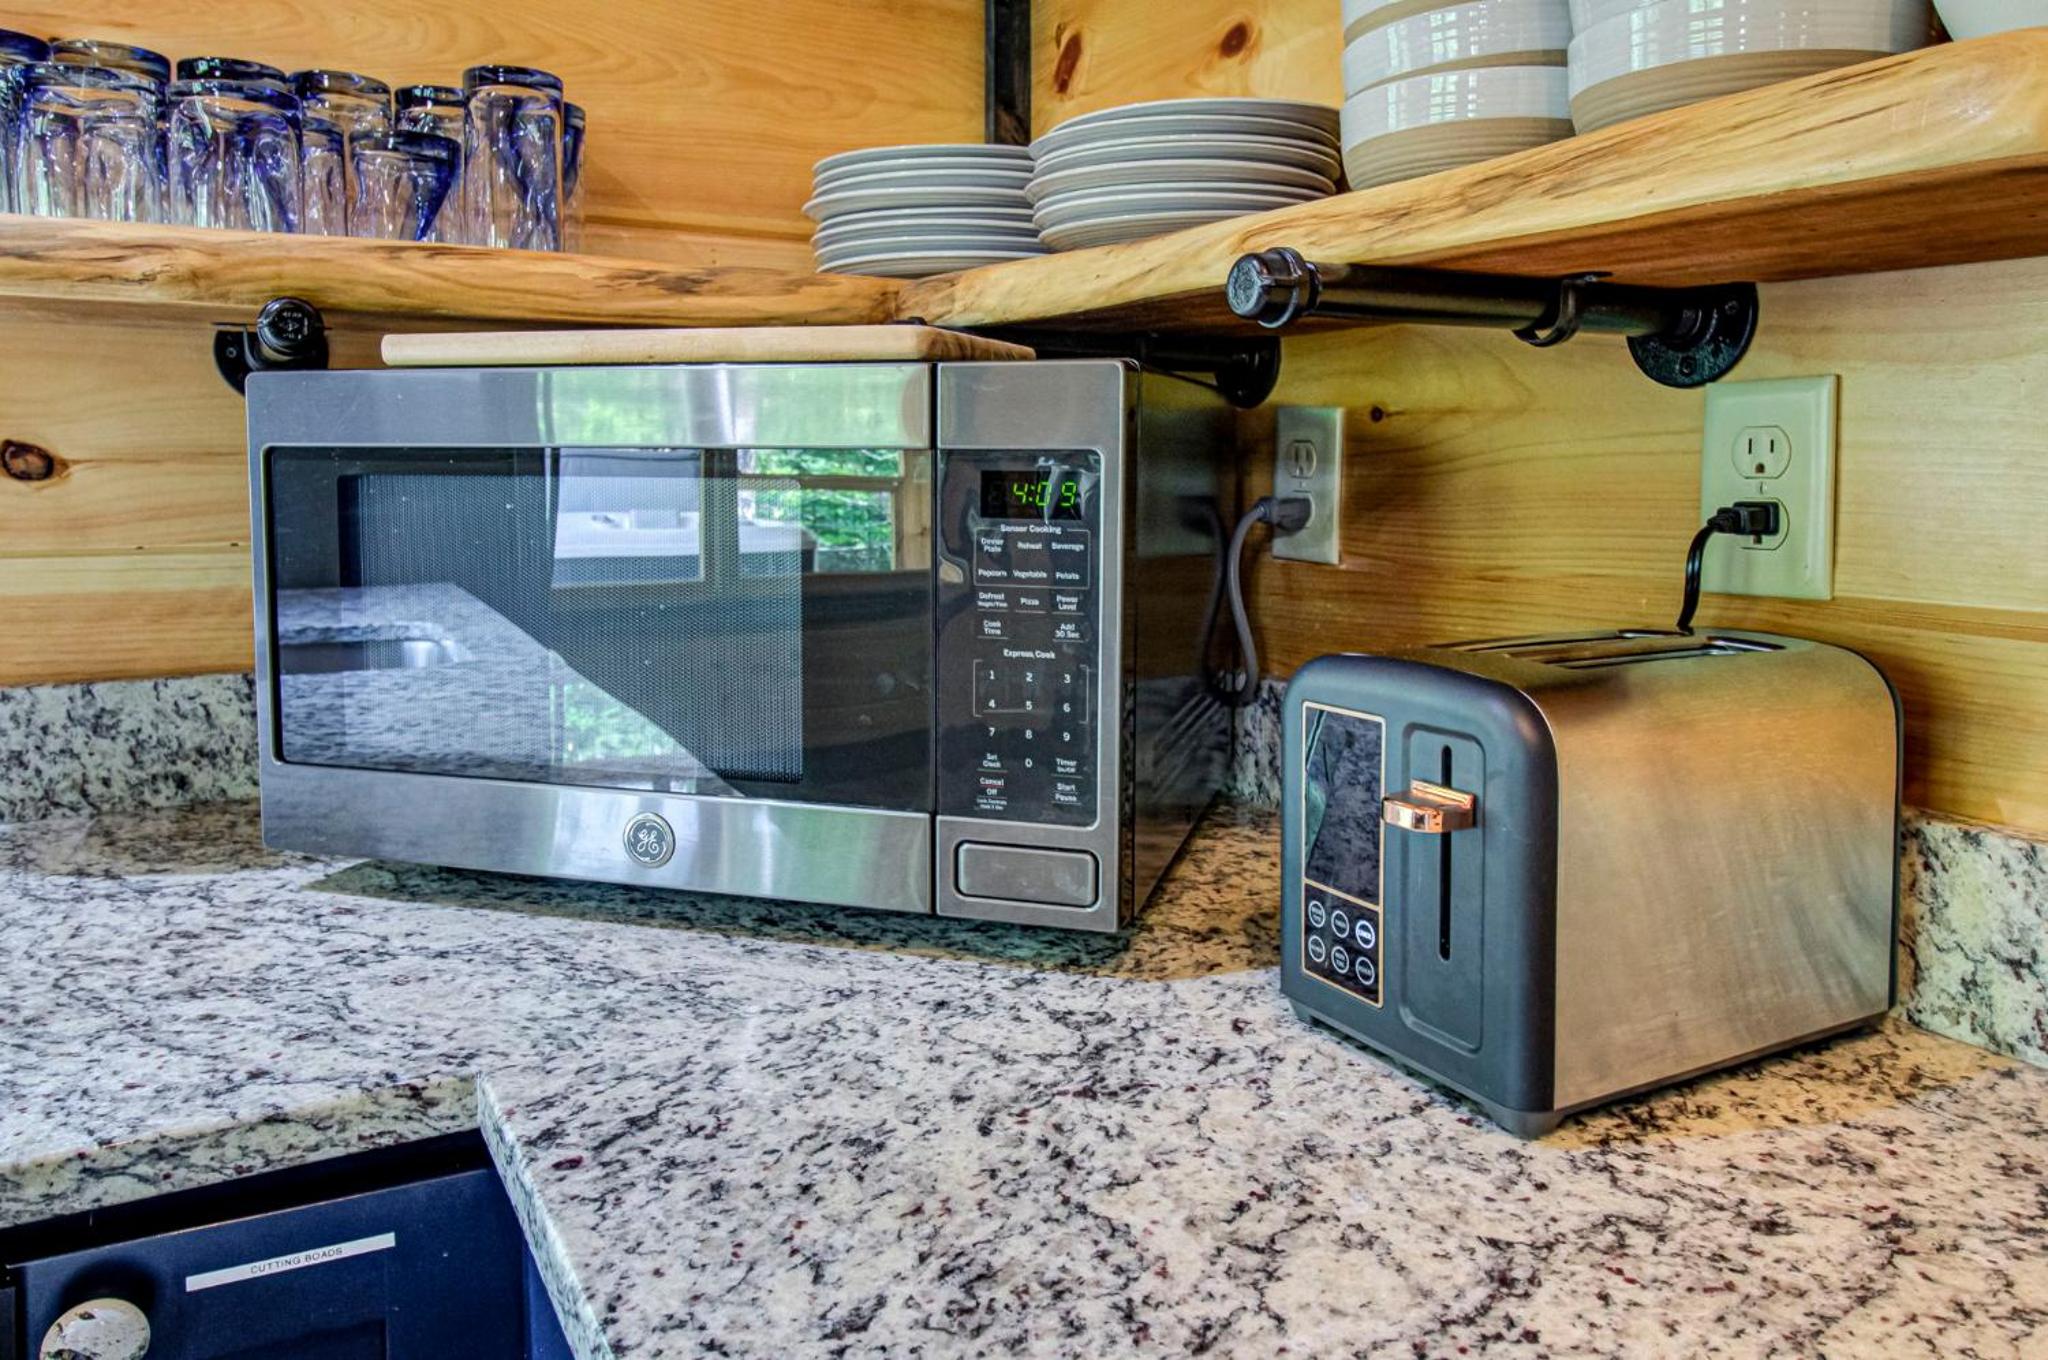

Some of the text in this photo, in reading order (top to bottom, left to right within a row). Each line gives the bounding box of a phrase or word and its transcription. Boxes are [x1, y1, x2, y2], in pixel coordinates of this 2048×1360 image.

[1013, 481, 1077, 507] 4:09
[1000, 524, 1062, 535] Sensor Cooking
[1051, 542, 1085, 552] Beverage
[978, 568, 1007, 577] Popcorn
[1058, 603, 1077, 611] Level
[1060, 623, 1075, 631] Add
[1055, 630, 1066, 638] 30
[1003, 648, 1056, 659] Express Cook
[989, 669, 996, 681] 1
[1025, 672, 1034, 683] 2
[1063, 674, 1072, 684] 3
[988, 699, 997, 709] 4
[1025, 700, 1034, 711] 5
[1062, 702, 1071, 713] 6
[989, 727, 997, 737] 7
[1024, 729, 1034, 740] 8
[1062, 732, 1071, 742] 9
[1024, 758, 1033, 768] 0
[1056, 758, 1078, 767] Timer
[979, 777, 1005, 786] Cancel
[250, 1247, 343, 1274] CUTTING BOADS
